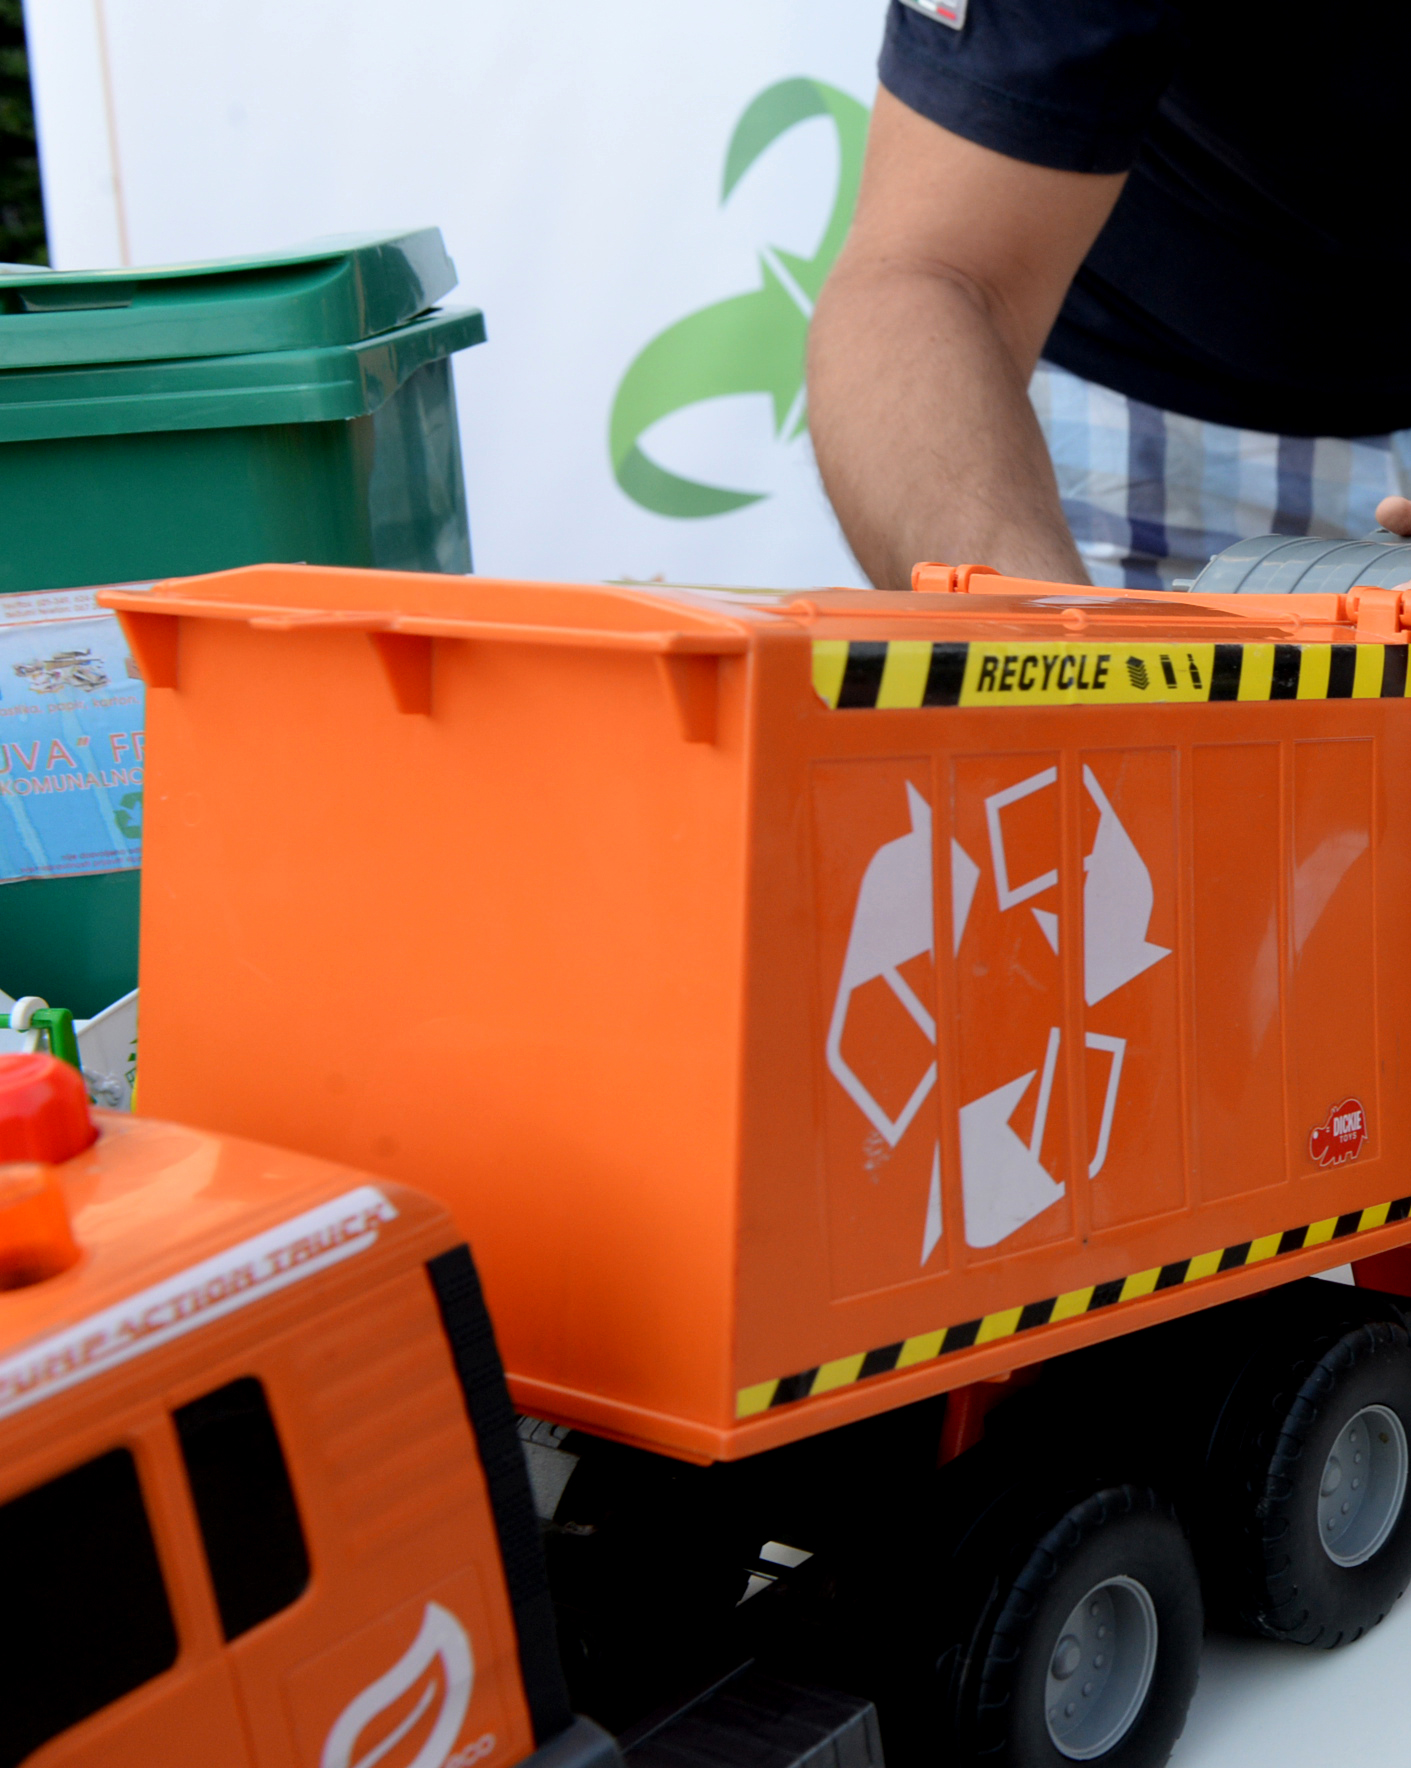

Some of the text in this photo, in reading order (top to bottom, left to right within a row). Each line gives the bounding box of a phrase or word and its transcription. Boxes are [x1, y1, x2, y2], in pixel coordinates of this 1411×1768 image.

[977, 654, 1111, 692] RECYCLE
[1333, 1110, 1362, 1137] DICKIE
[1339, 1132, 1357, 1143] TOYS
[0, 1202, 387, 1394] UMP ACTION TRUCK
